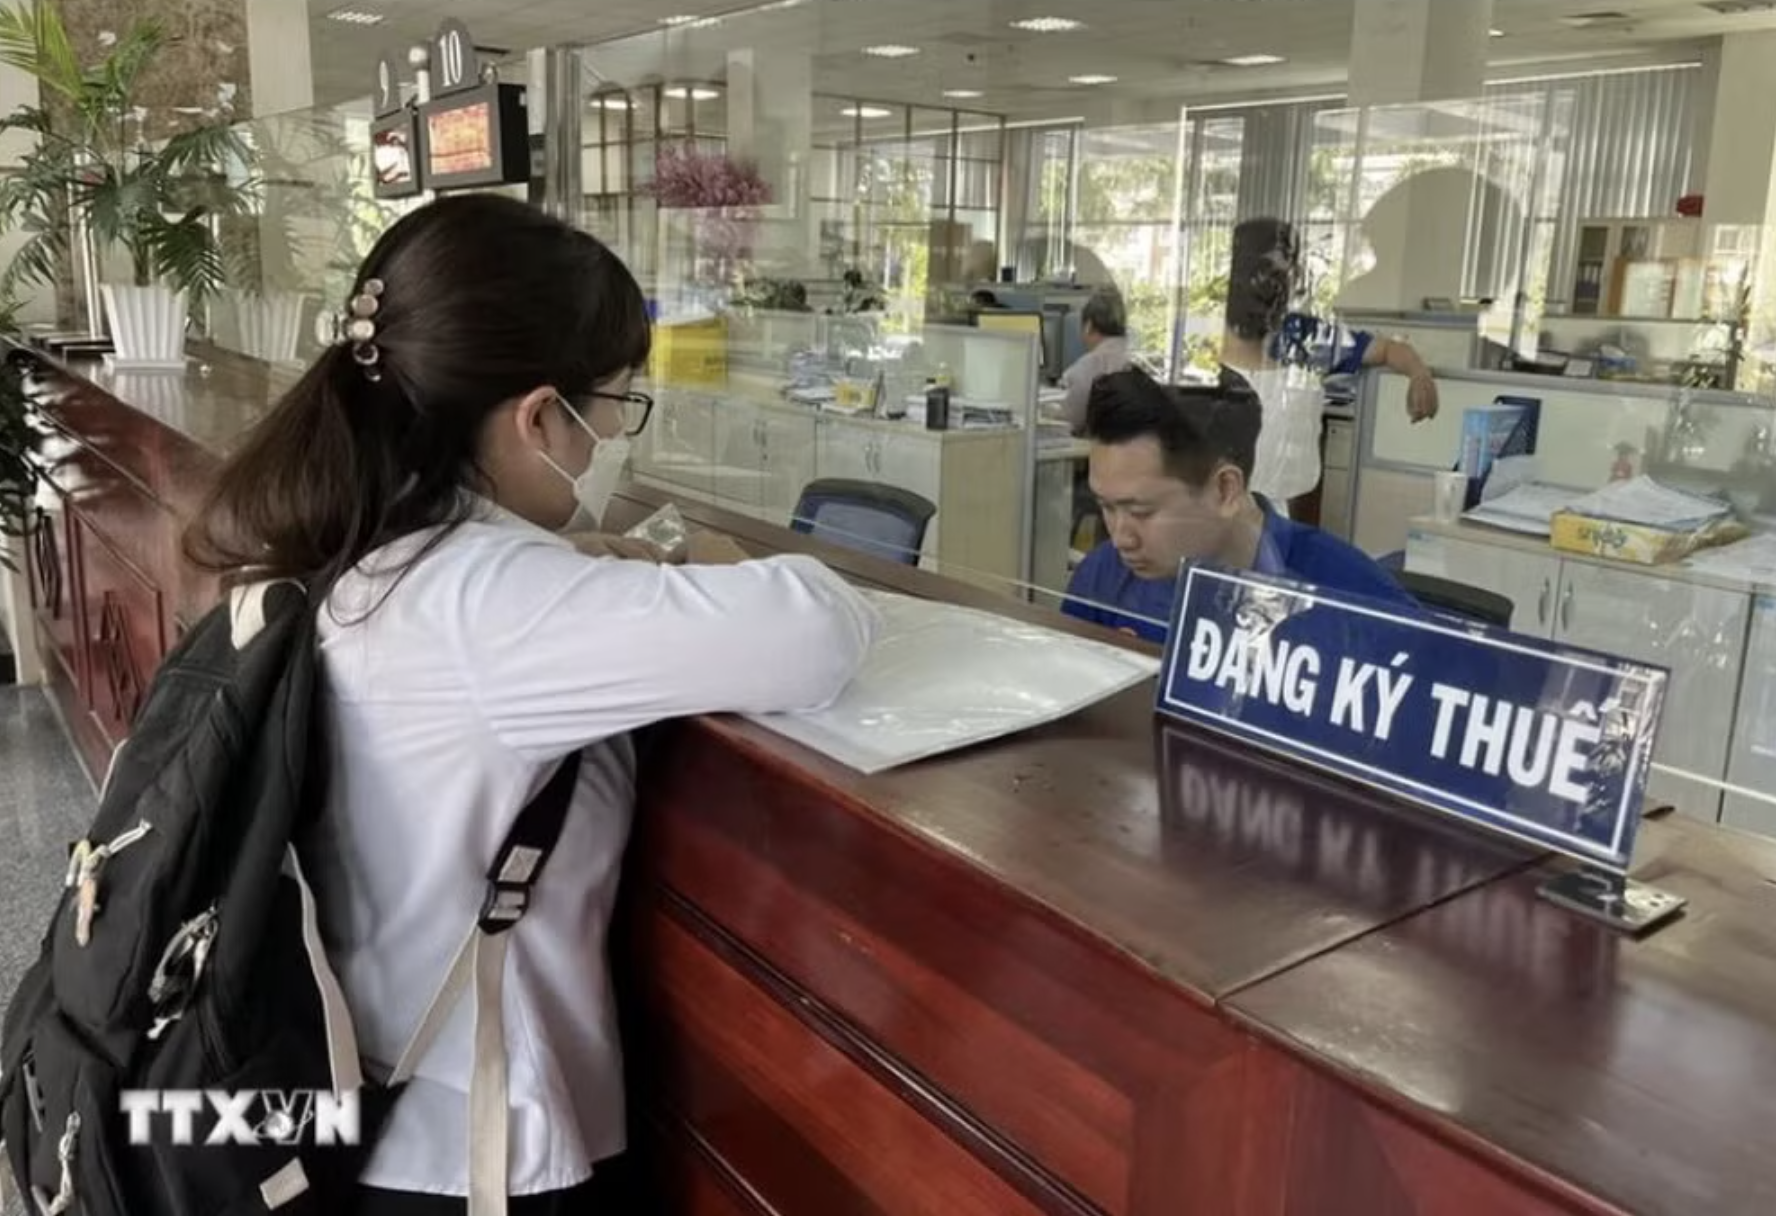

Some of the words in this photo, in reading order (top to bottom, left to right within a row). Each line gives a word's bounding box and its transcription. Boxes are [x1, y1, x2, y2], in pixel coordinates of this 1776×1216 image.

[379, 60, 389, 108] 9
[439, 31, 463, 86] 10
[1331, 652, 1414, 740] KÝ
[1430, 682, 1621, 804] THUẾ
